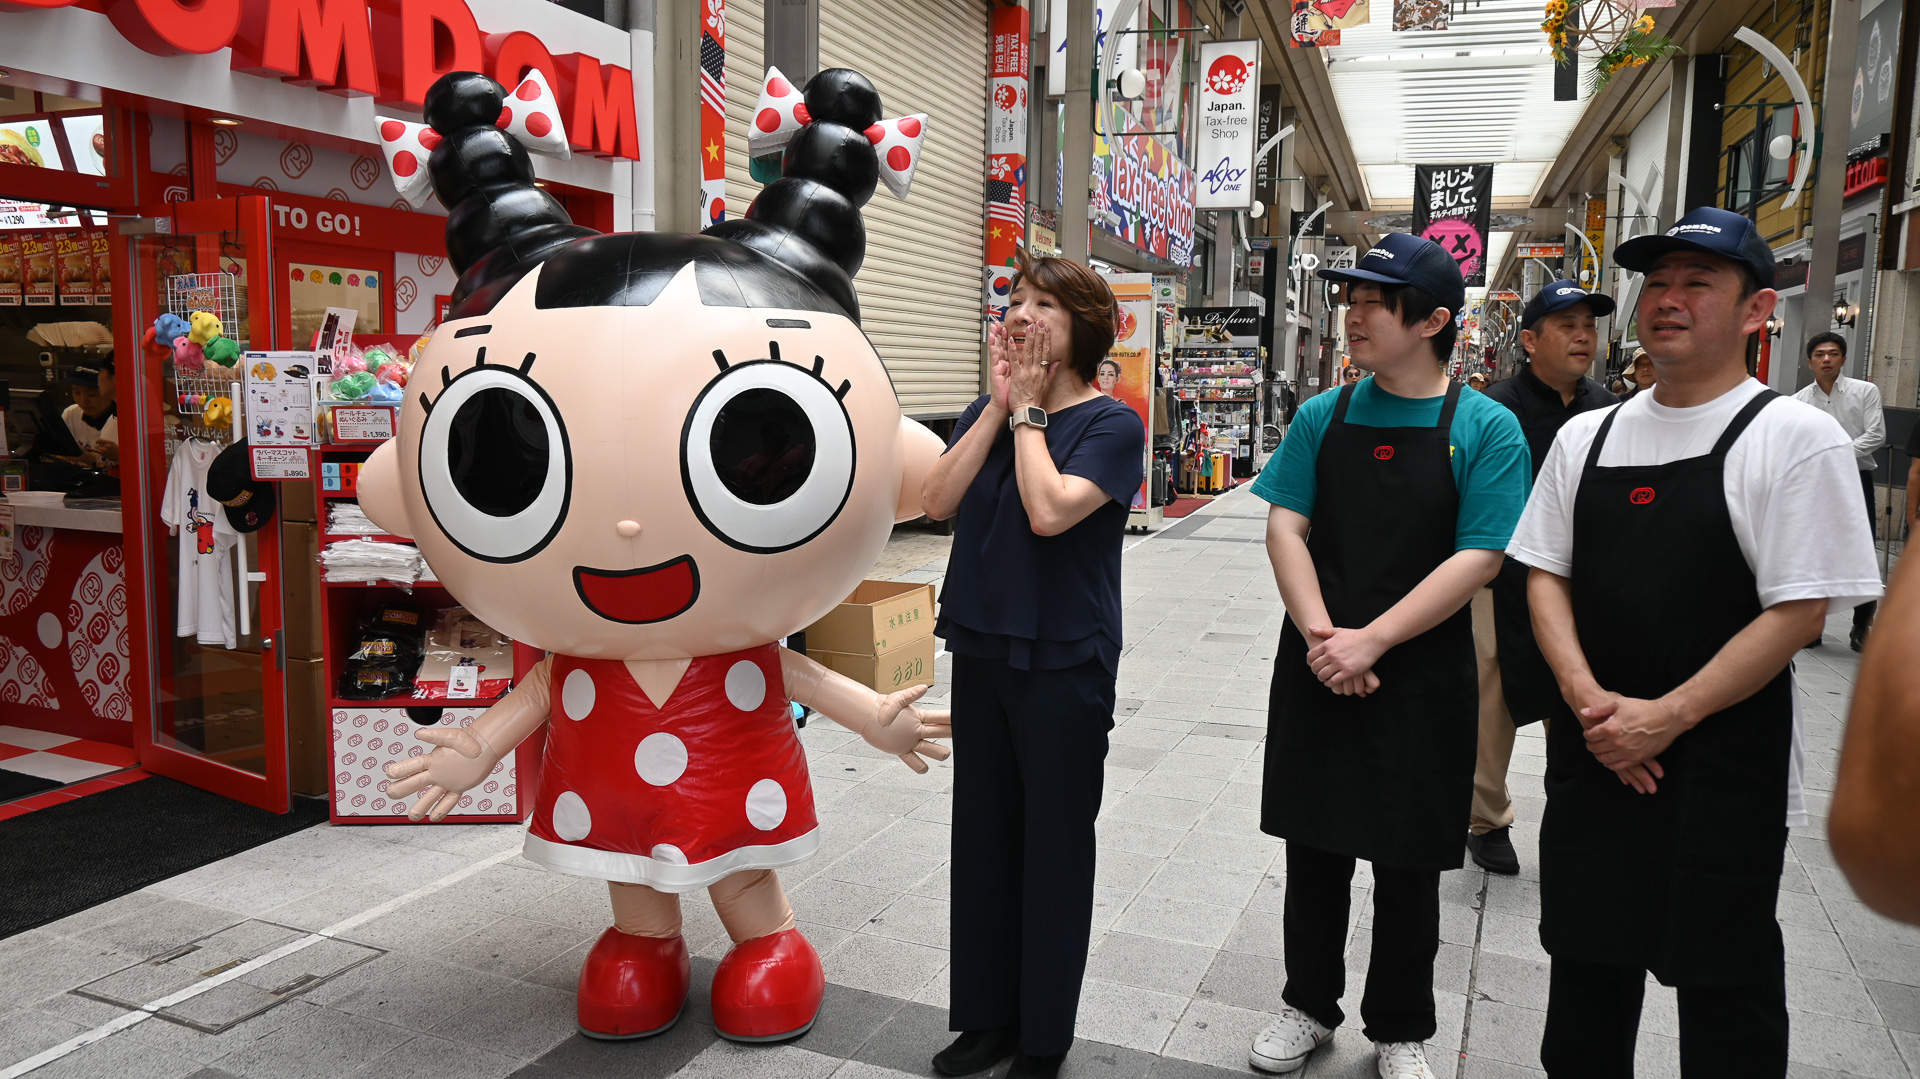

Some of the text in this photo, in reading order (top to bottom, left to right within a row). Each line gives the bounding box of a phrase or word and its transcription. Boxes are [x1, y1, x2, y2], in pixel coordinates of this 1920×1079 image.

[1010, 33, 1019, 72] TAX FREE
[1207, 101, 1245, 113] Japan.
[1205, 115, 1247, 126] Tax-free
[1260, 117, 1270, 140] 2nd
[1211, 128, 1239, 140] Shop
[1430, 186, 1477, 210] まして、
[274, 204, 361, 237] TO GO!
[1202, 308, 1257, 333] Perfume
